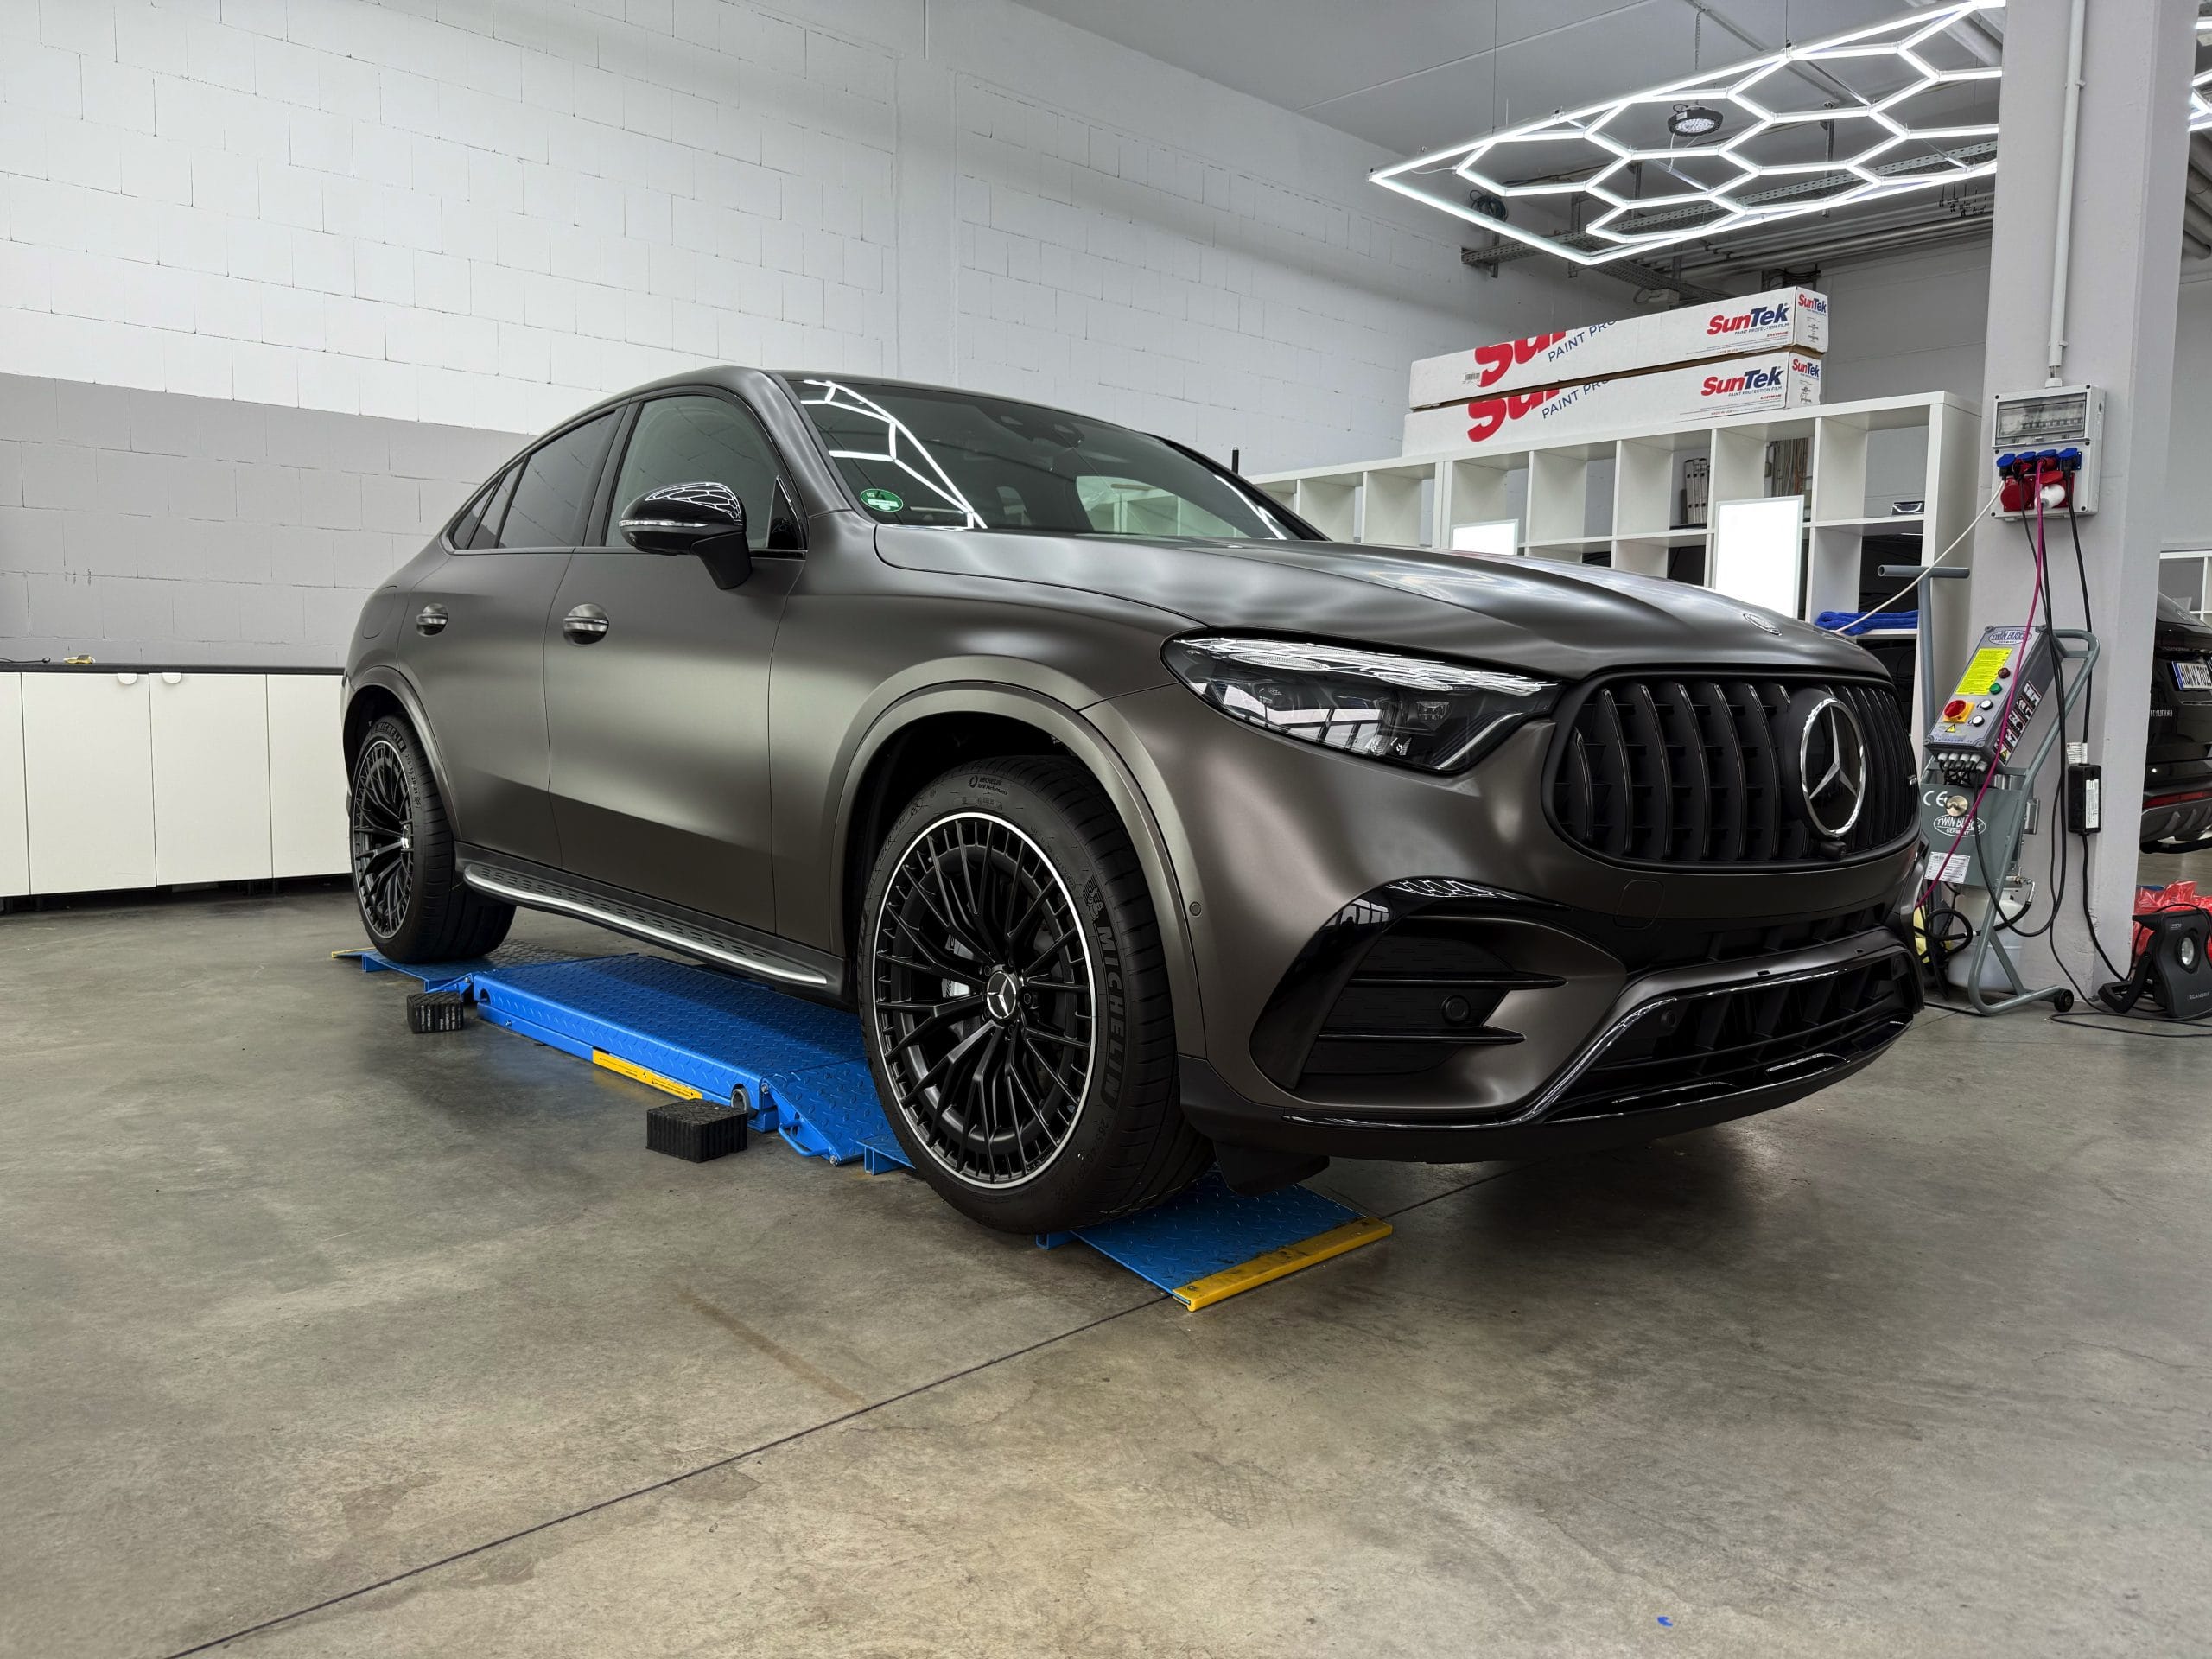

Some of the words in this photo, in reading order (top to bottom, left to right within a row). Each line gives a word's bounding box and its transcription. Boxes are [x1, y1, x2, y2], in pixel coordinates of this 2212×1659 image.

[1798, 293, 1827, 313] SunTek
[1707, 303, 1790, 335] SunTek
[1548, 332, 1585, 362] PAINT
[1700, 366, 1783, 396] SunTek
[1792, 358, 1820, 378] SunTek
[1541, 390, 1579, 419] PAINT
[1583, 380, 1608, 395] PR
[1937, 816, 1955, 827] TWIN
[1096, 926, 1125, 1099] MICHELIN
